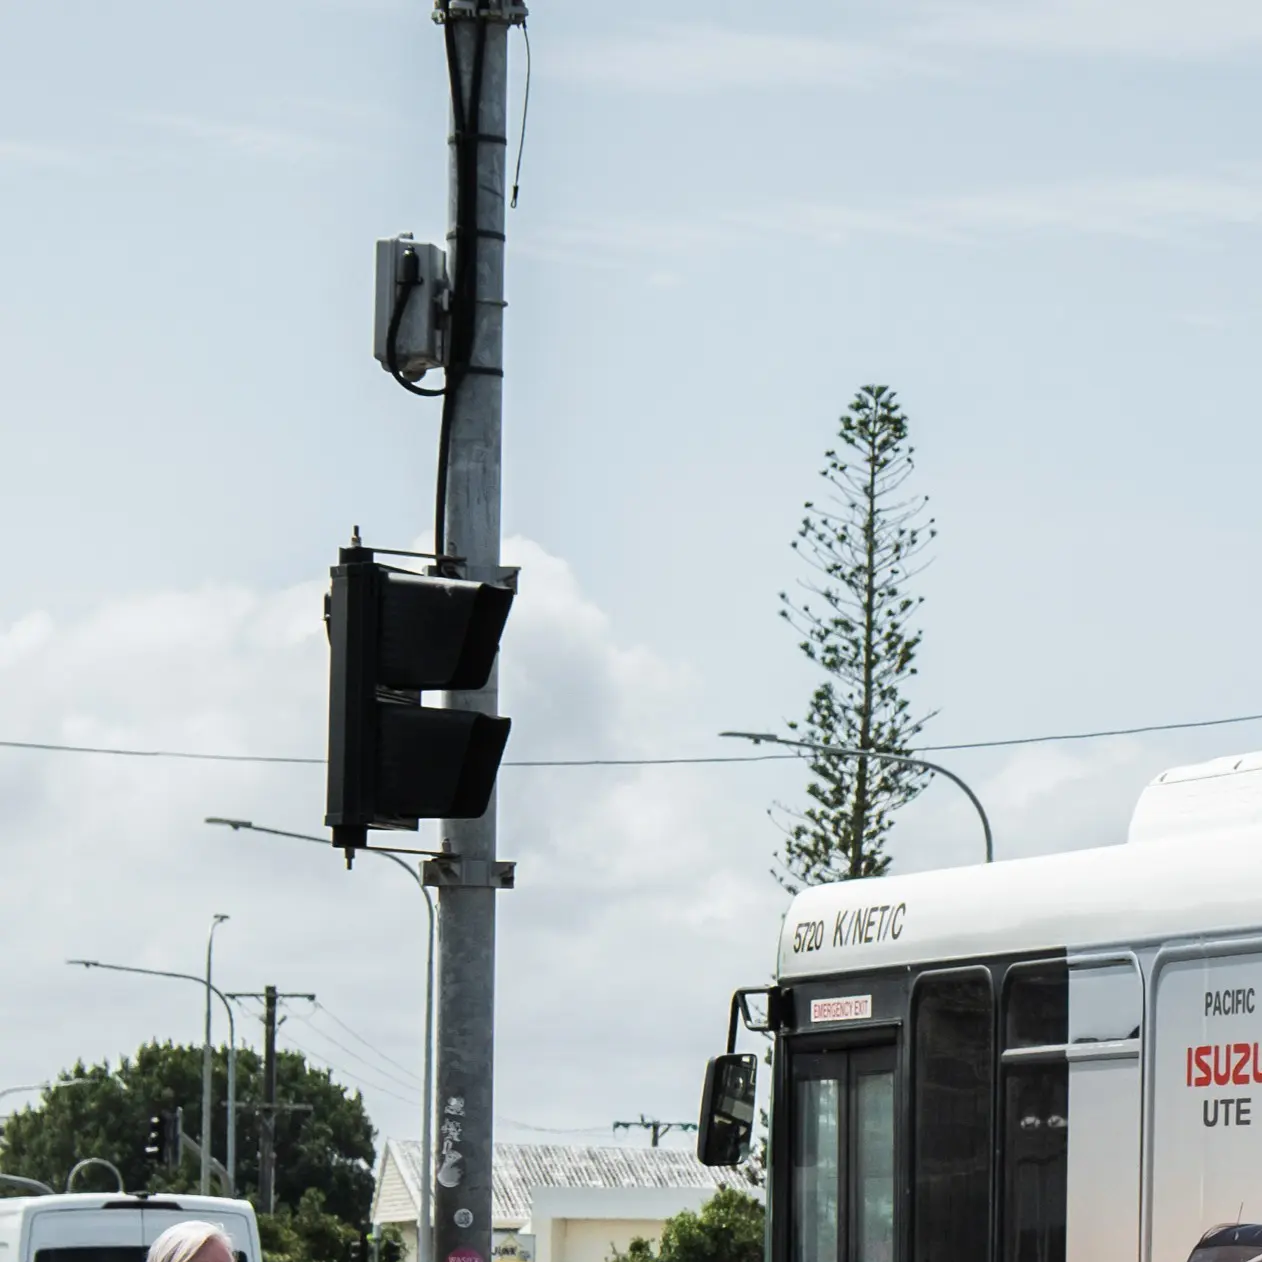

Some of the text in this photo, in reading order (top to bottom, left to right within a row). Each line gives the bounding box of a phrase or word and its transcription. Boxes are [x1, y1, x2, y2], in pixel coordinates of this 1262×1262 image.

[793, 920, 825, 953] 5720
[813, 1000, 868, 1019] EMERGENCY EXIT
[1204, 988, 1255, 1017] PACIFIC
[1203, 1097, 1252, 1128] UTE
